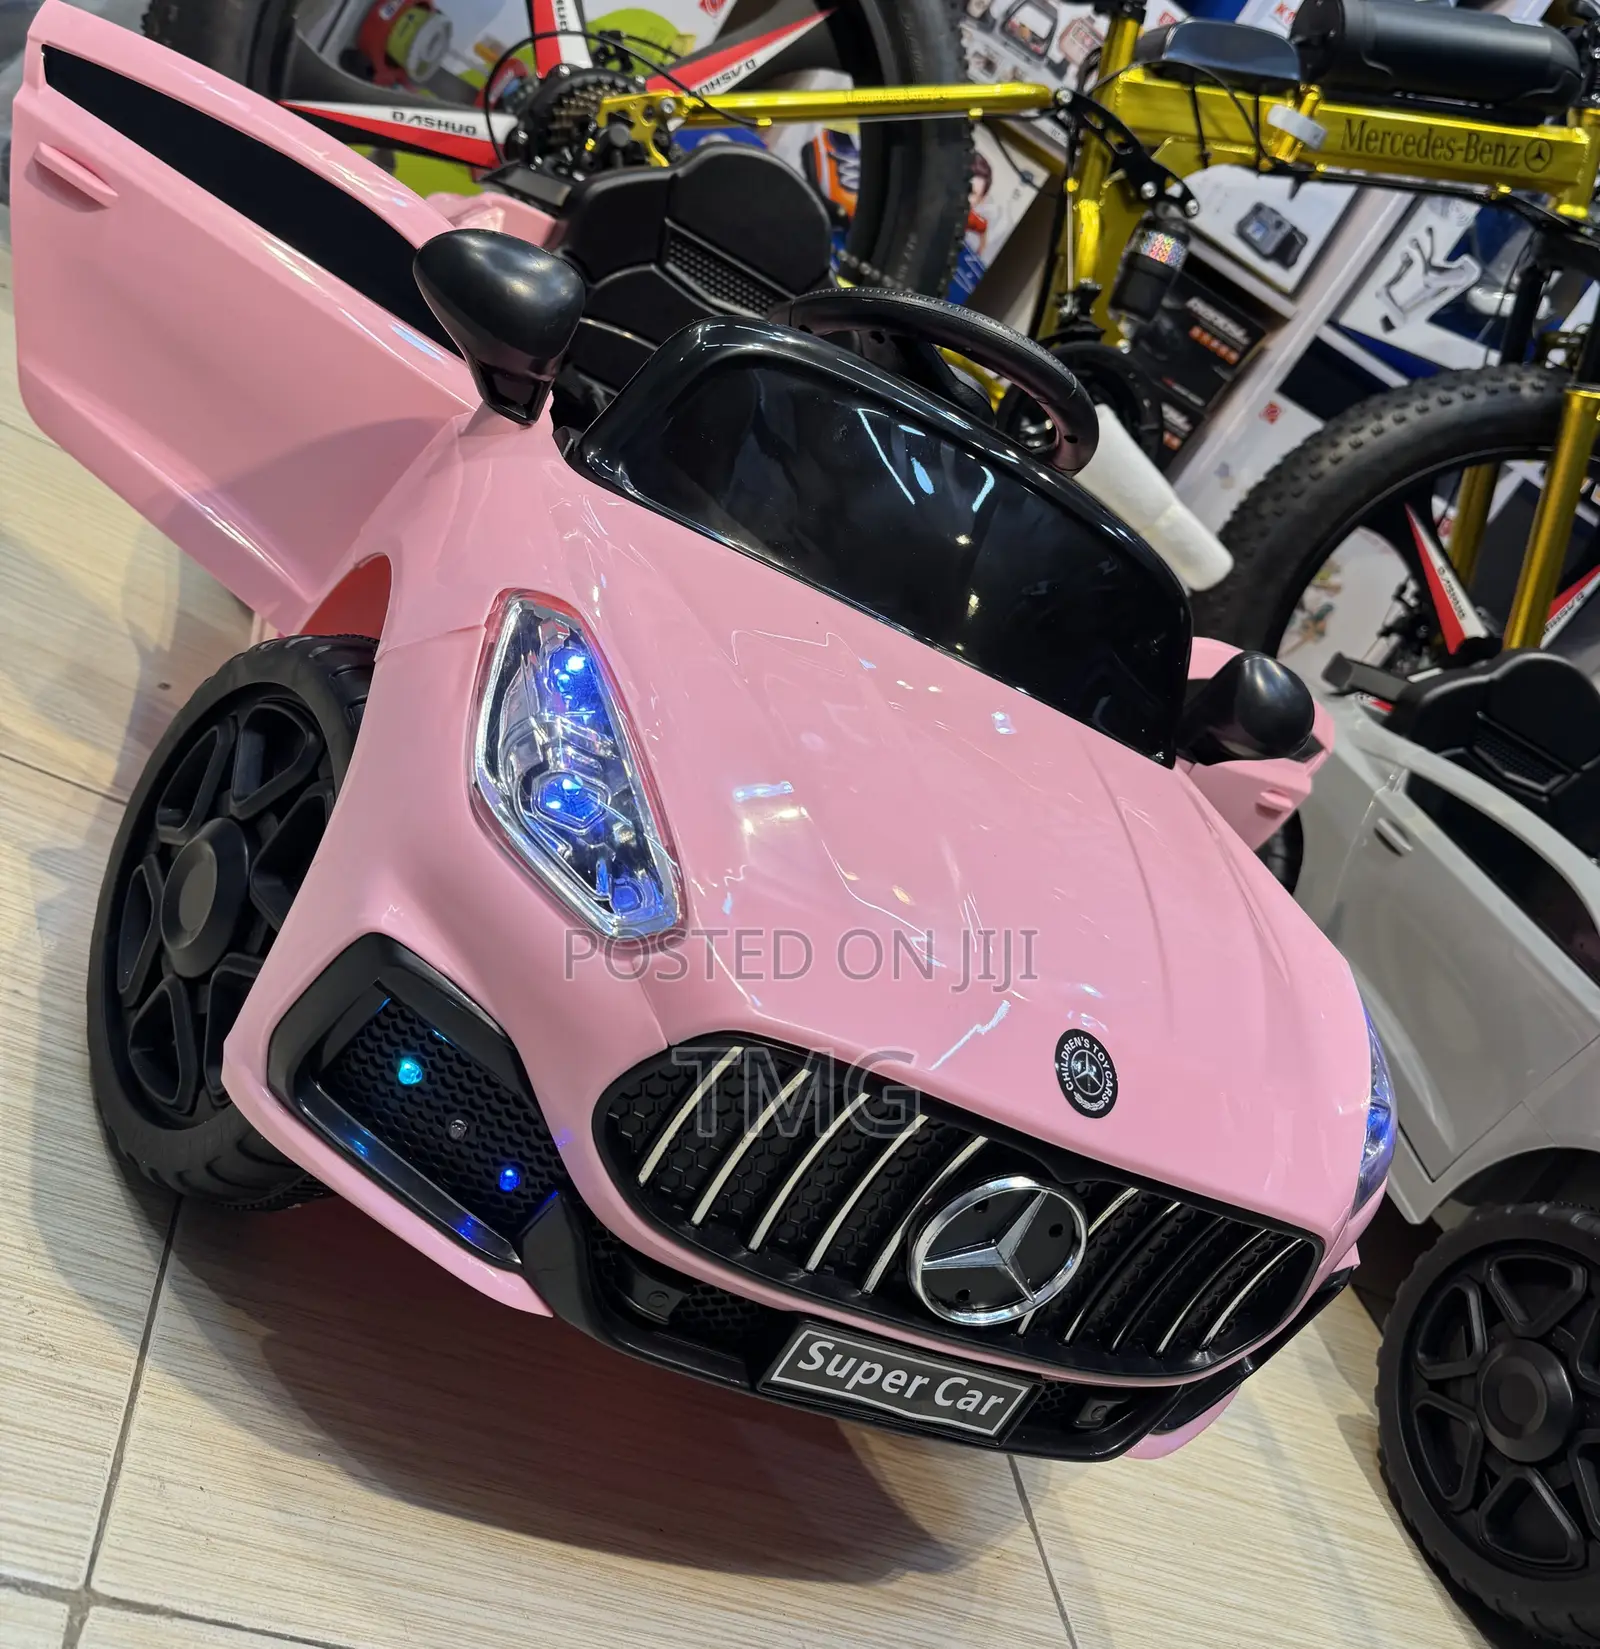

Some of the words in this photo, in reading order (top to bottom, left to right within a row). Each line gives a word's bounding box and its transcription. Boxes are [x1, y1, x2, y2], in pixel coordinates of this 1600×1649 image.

[1341, 118, 1520, 168] Mercedes-Benz
[1060, 1035, 1091, 1091] CHILDREN'S
[797, 1340, 930, 1390] Super
[934, 1376, 1005, 1416] Car
